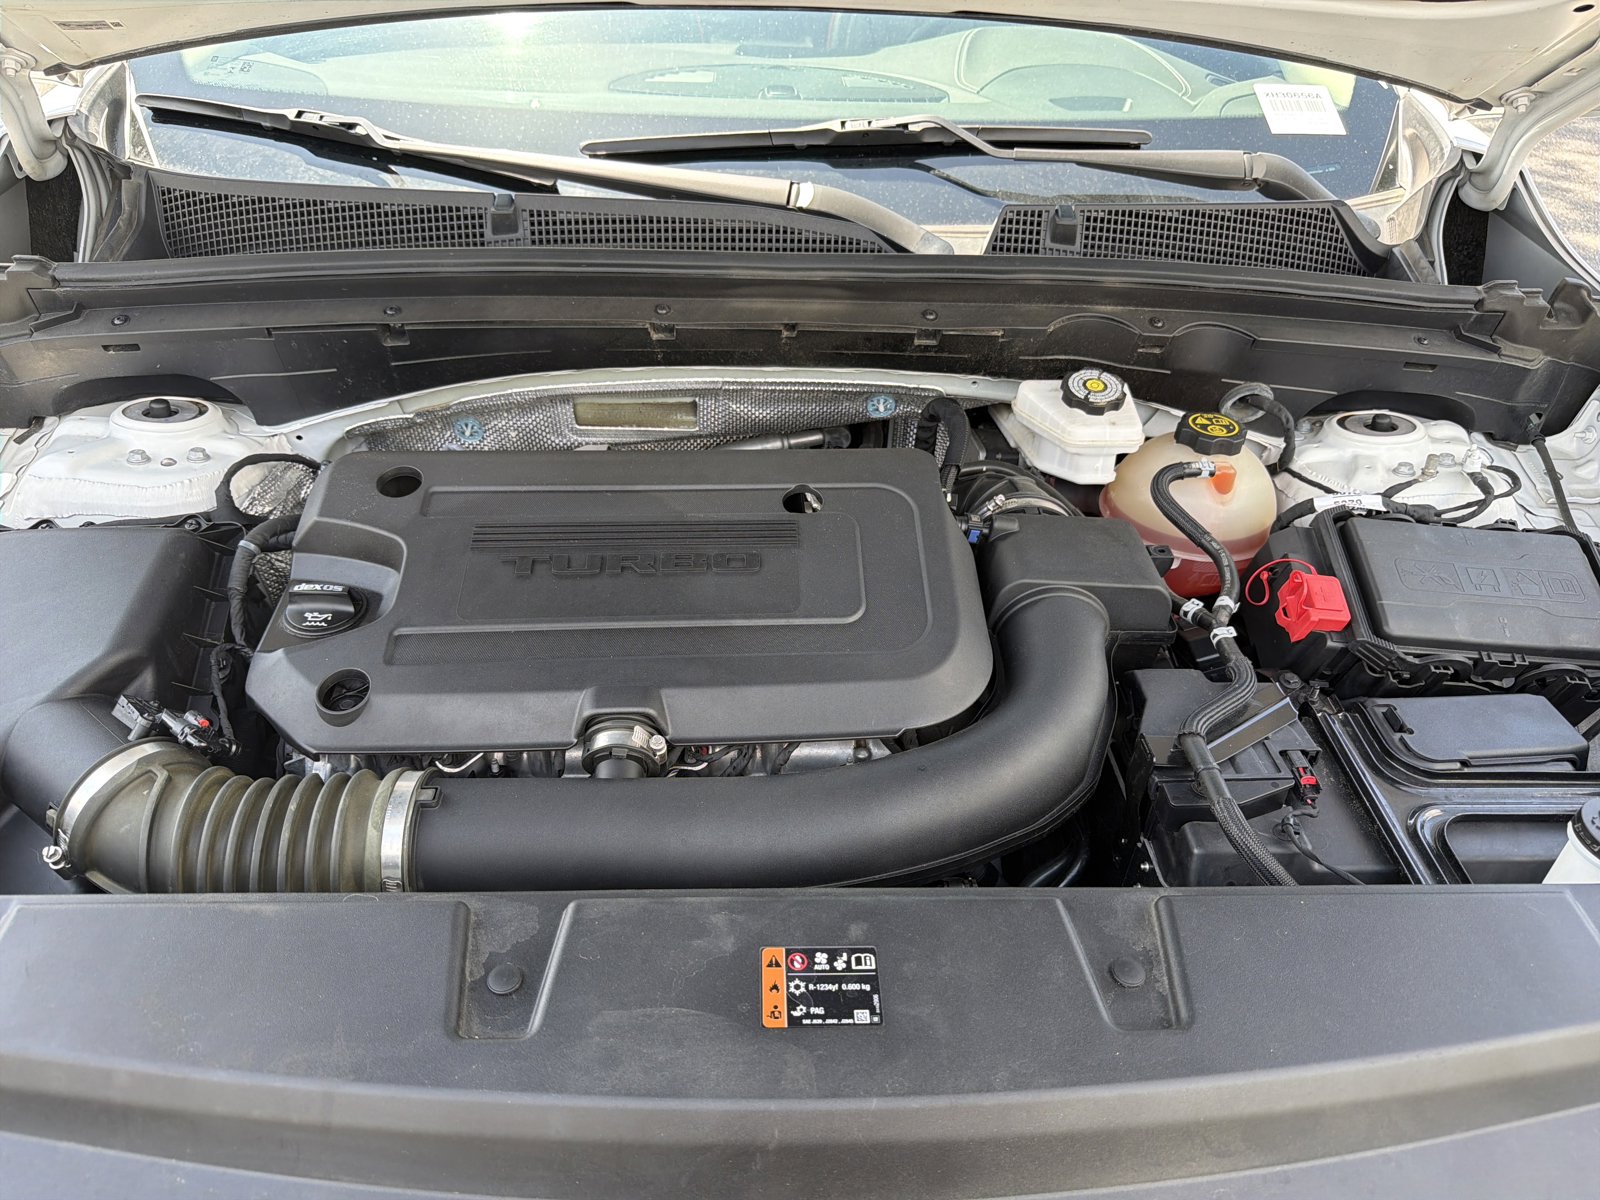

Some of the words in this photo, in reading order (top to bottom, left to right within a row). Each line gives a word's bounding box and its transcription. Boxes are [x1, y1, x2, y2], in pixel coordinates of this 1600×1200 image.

[499, 549, 762, 577] TURBO
[293, 583, 345, 592] dexos
[808, 983, 839, 992] R-1234yf
[861, 983, 871, 991] kg
[810, 1007, 825, 1015] PAG
